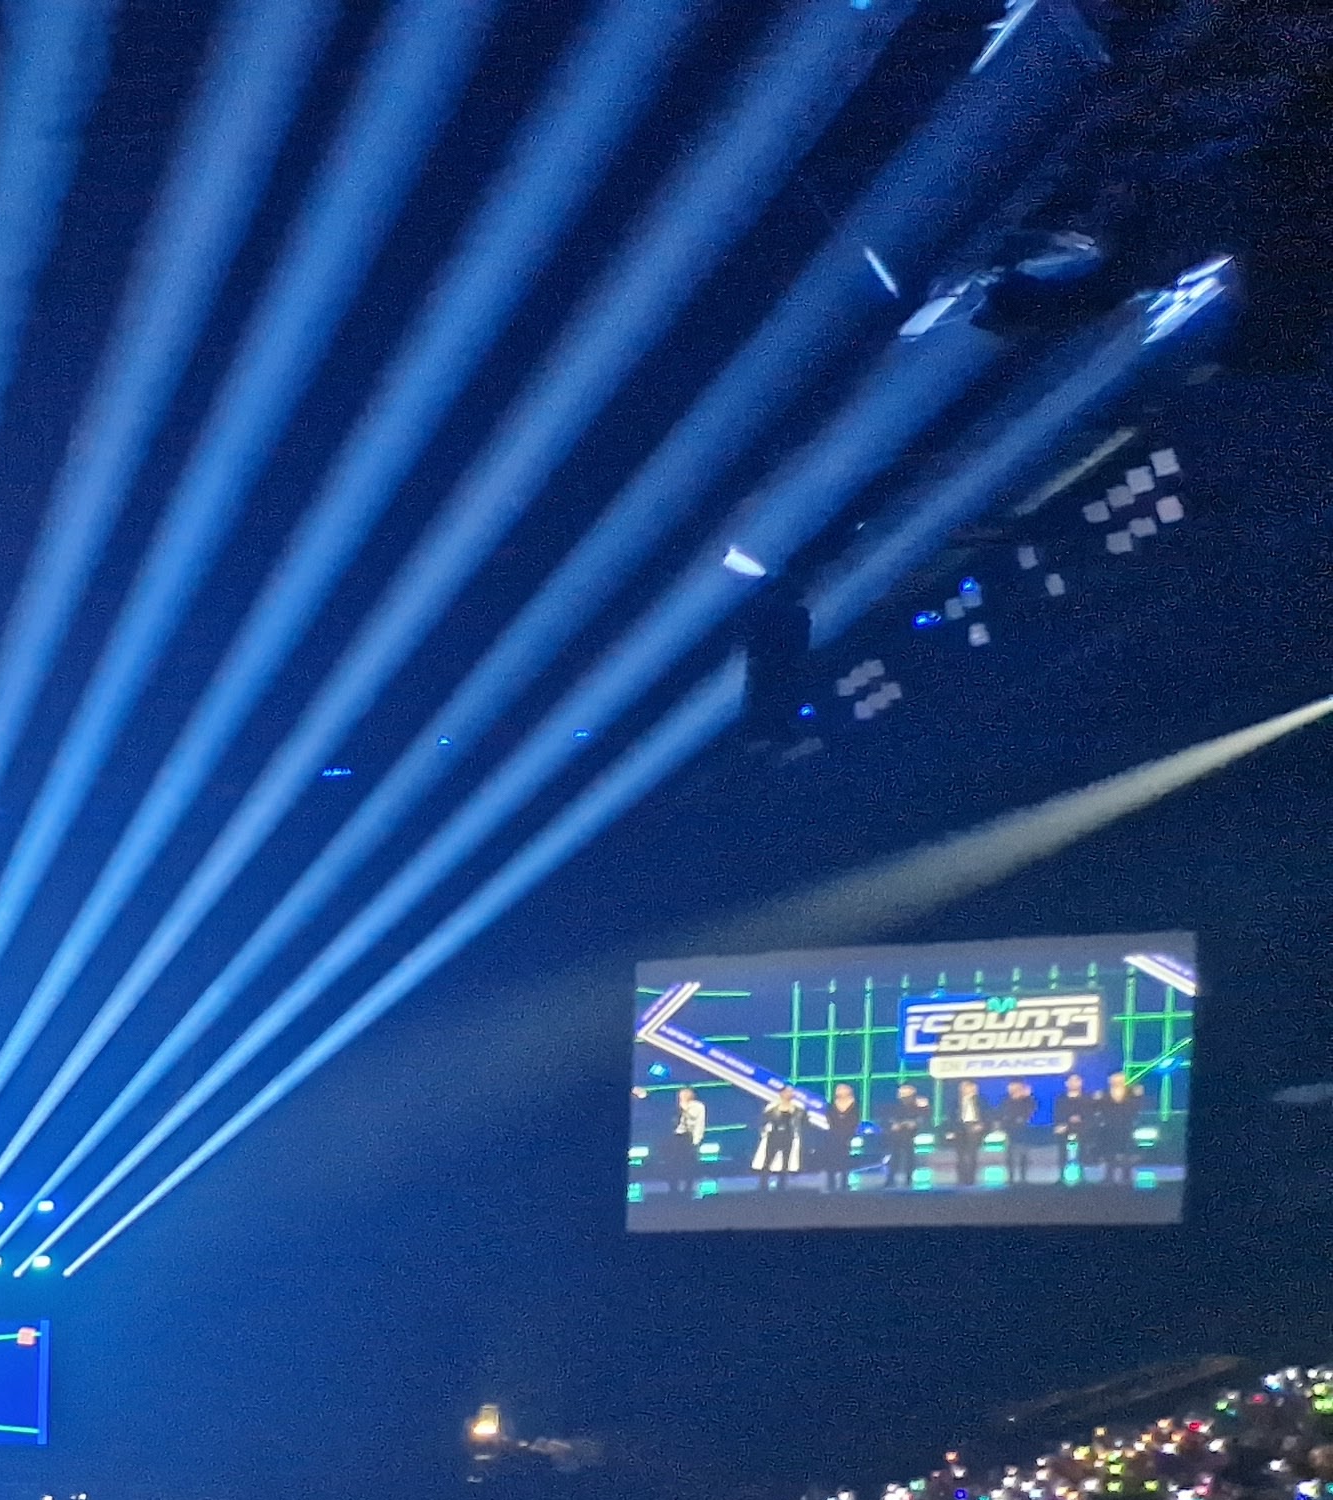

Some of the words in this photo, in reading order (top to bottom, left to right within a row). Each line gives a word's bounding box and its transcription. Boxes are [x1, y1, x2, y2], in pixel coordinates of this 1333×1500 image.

[921, 1007, 1083, 1033] COUNT
[938, 1029, 1063, 1052] DOWN
[965, 1057, 1062, 1070] FRANCE
